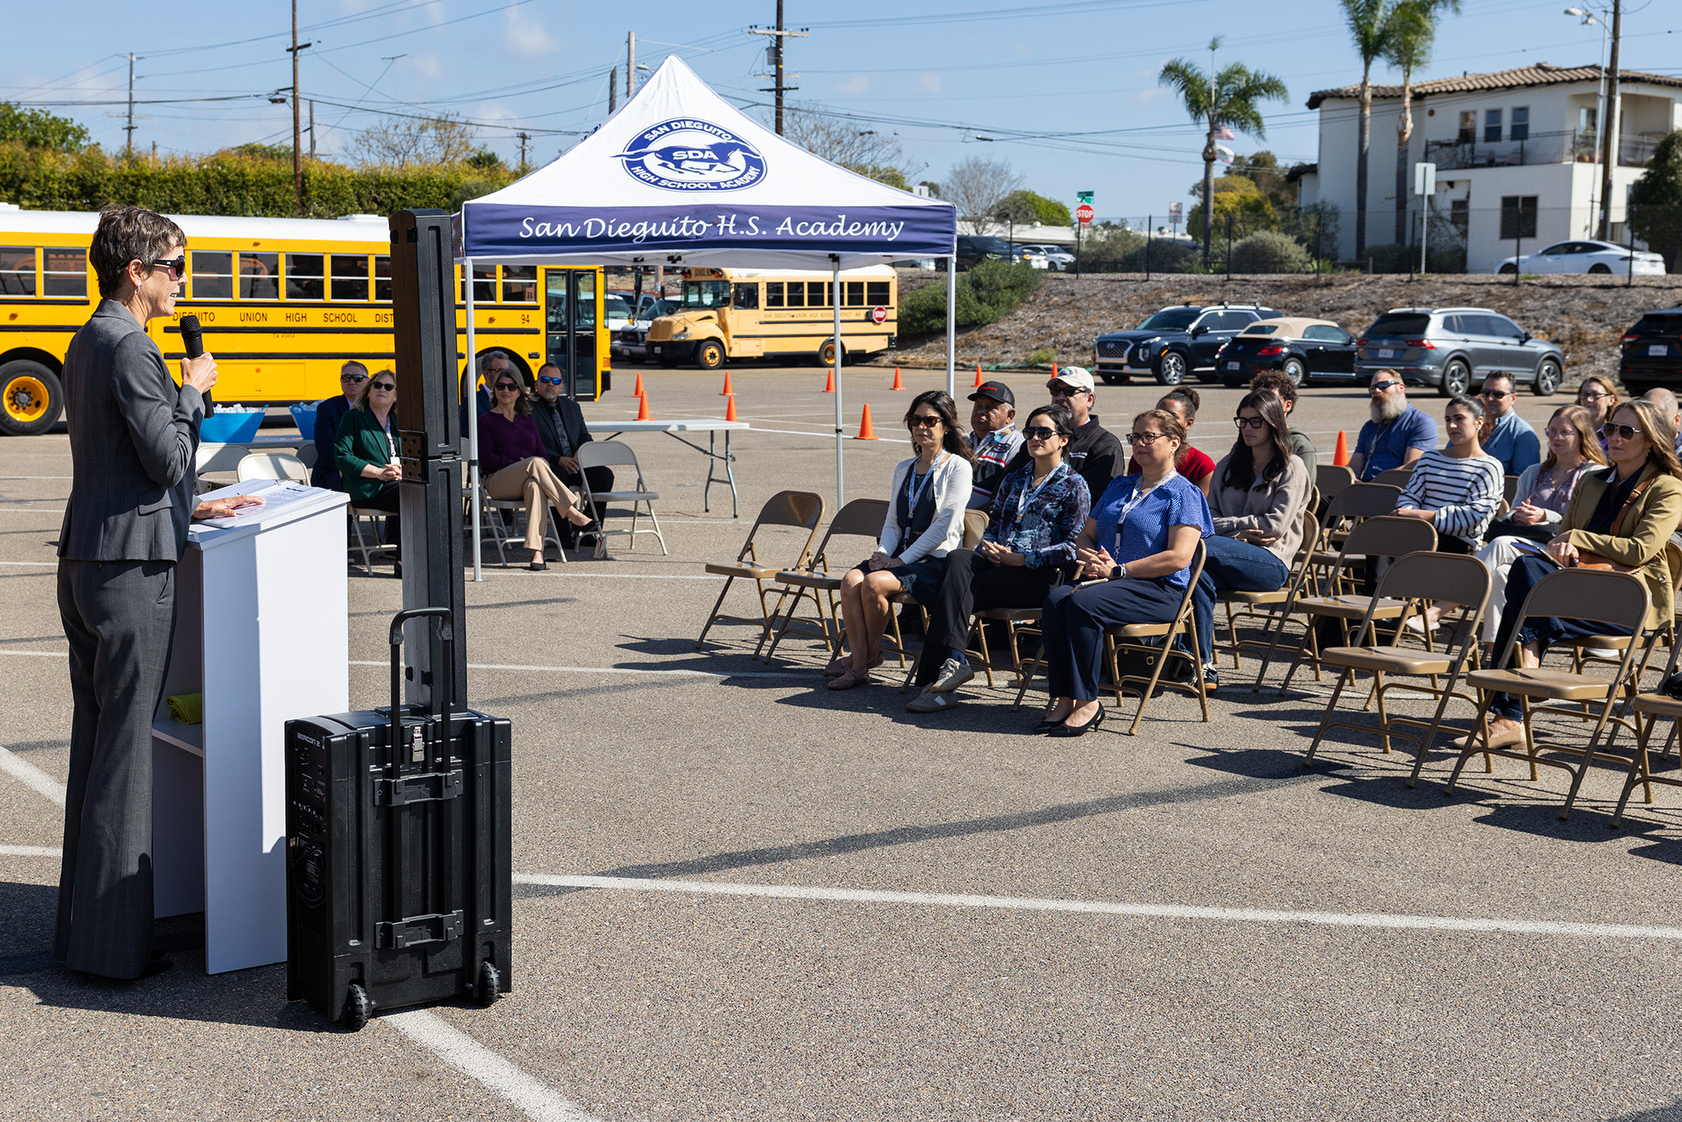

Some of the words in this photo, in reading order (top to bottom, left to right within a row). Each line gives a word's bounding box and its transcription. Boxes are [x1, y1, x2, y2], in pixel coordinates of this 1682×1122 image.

[644, 125, 670, 141] SAN
[670, 121, 733, 141] DIEGUITO
[672, 151, 719, 160] SDA
[631, 166, 658, 183] HIGH
[658, 179, 717, 189] SCHOOL
[720, 167, 761, 189] ACADEMY
[1076, 210, 1094, 219] STOP
[519, 216, 581, 239] San
[583, 216, 713, 244] Dieguito
[717, 214, 767, 236] H.S.
[775, 214, 905, 241] Academy
[240, 312, 268, 322] UNION
[285, 312, 307, 322] HIGH
[323, 313, 357, 323] SCHOOL
[521, 314, 530, 324] 94
